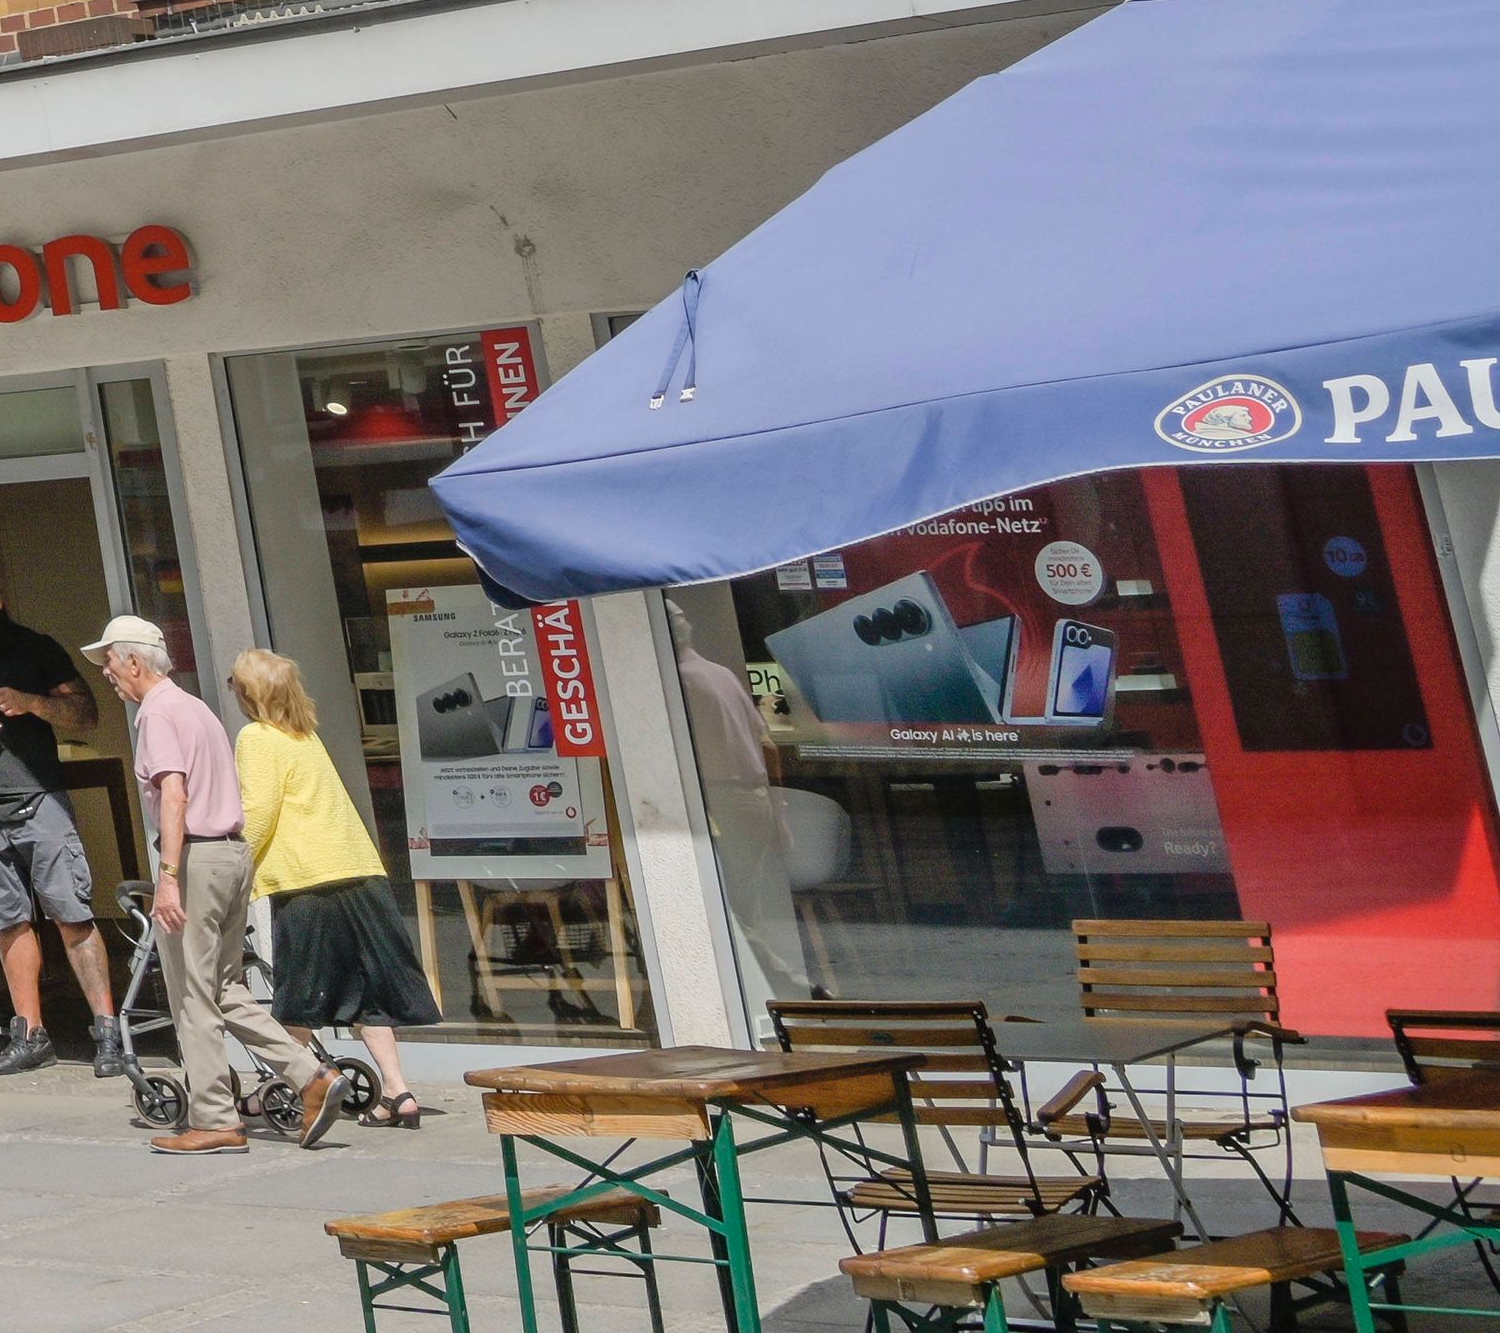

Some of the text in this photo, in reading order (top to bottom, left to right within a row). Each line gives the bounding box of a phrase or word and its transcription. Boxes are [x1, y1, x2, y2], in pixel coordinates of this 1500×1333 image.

[443, 344, 480, 406] FÜR
[1171, 381, 1288, 415] PAULANER
[1171, 431, 1272, 448] MÜNCHEN
[1010, 496, 1033, 511] im
[1046, 563, 1092, 578] 500 €
[413, 612, 456, 622] SAMSUNG
[444, 631, 472, 639] Galaxy
[478, 628, 499, 637] Fold6
[890, 728, 1018, 744] Galaxy AI is here
[1164, 842, 1216, 857] Ready?
